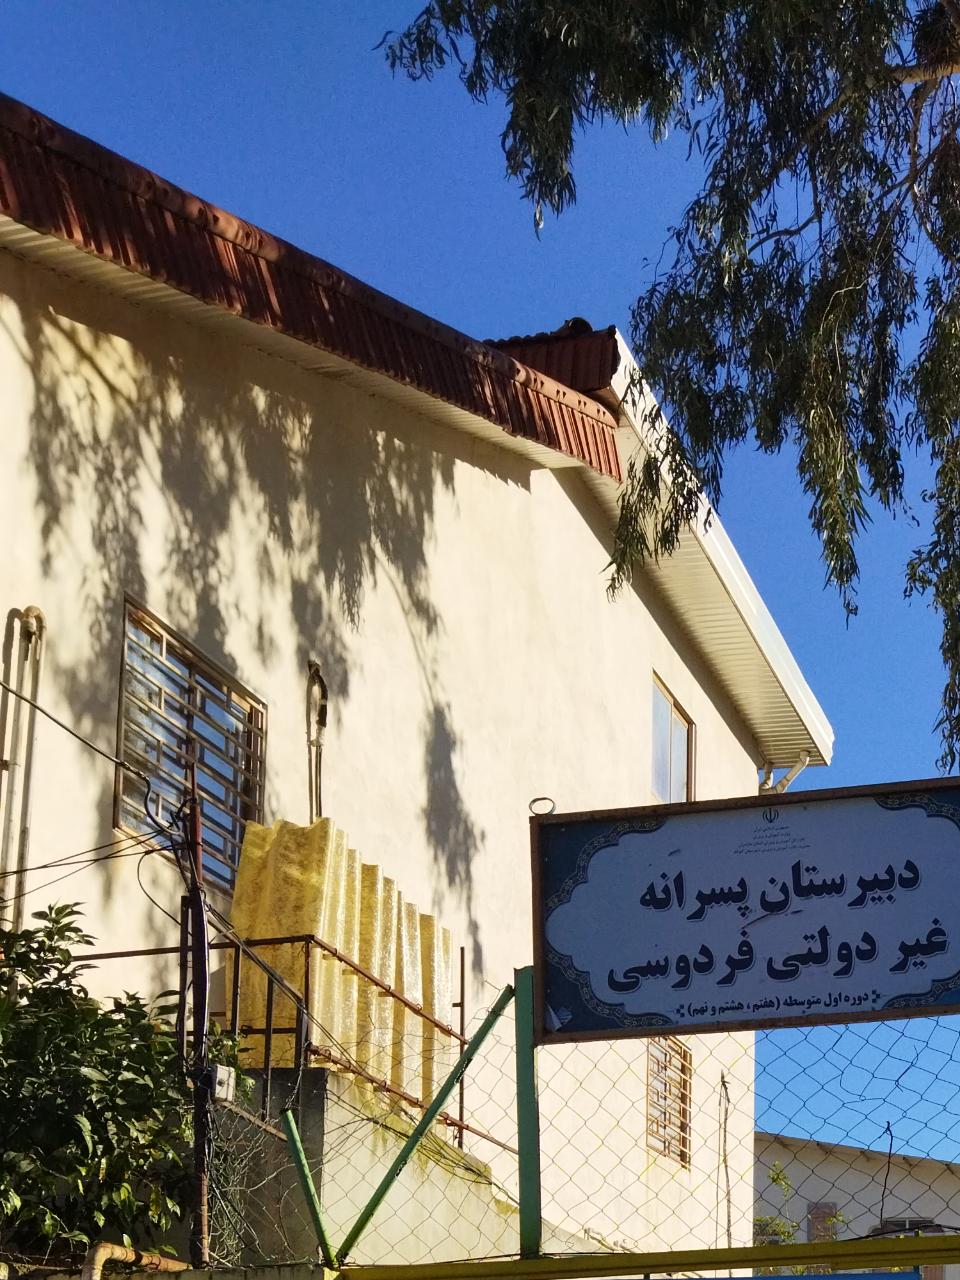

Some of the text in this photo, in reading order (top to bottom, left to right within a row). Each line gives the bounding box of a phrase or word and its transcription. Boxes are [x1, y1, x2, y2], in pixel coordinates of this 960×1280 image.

[639, 858, 921, 921] دبیرستان پسرانه
[607, 917, 949, 993] غیر دولتی فردوسی
[782, 994, 822, 1009] متوسطه
[824, 992, 842, 1008] اول
[843, 991, 869, 1006] دوره
[710, 1006, 717, 1015] و
[718, 1000, 745, 1015] هشتم
